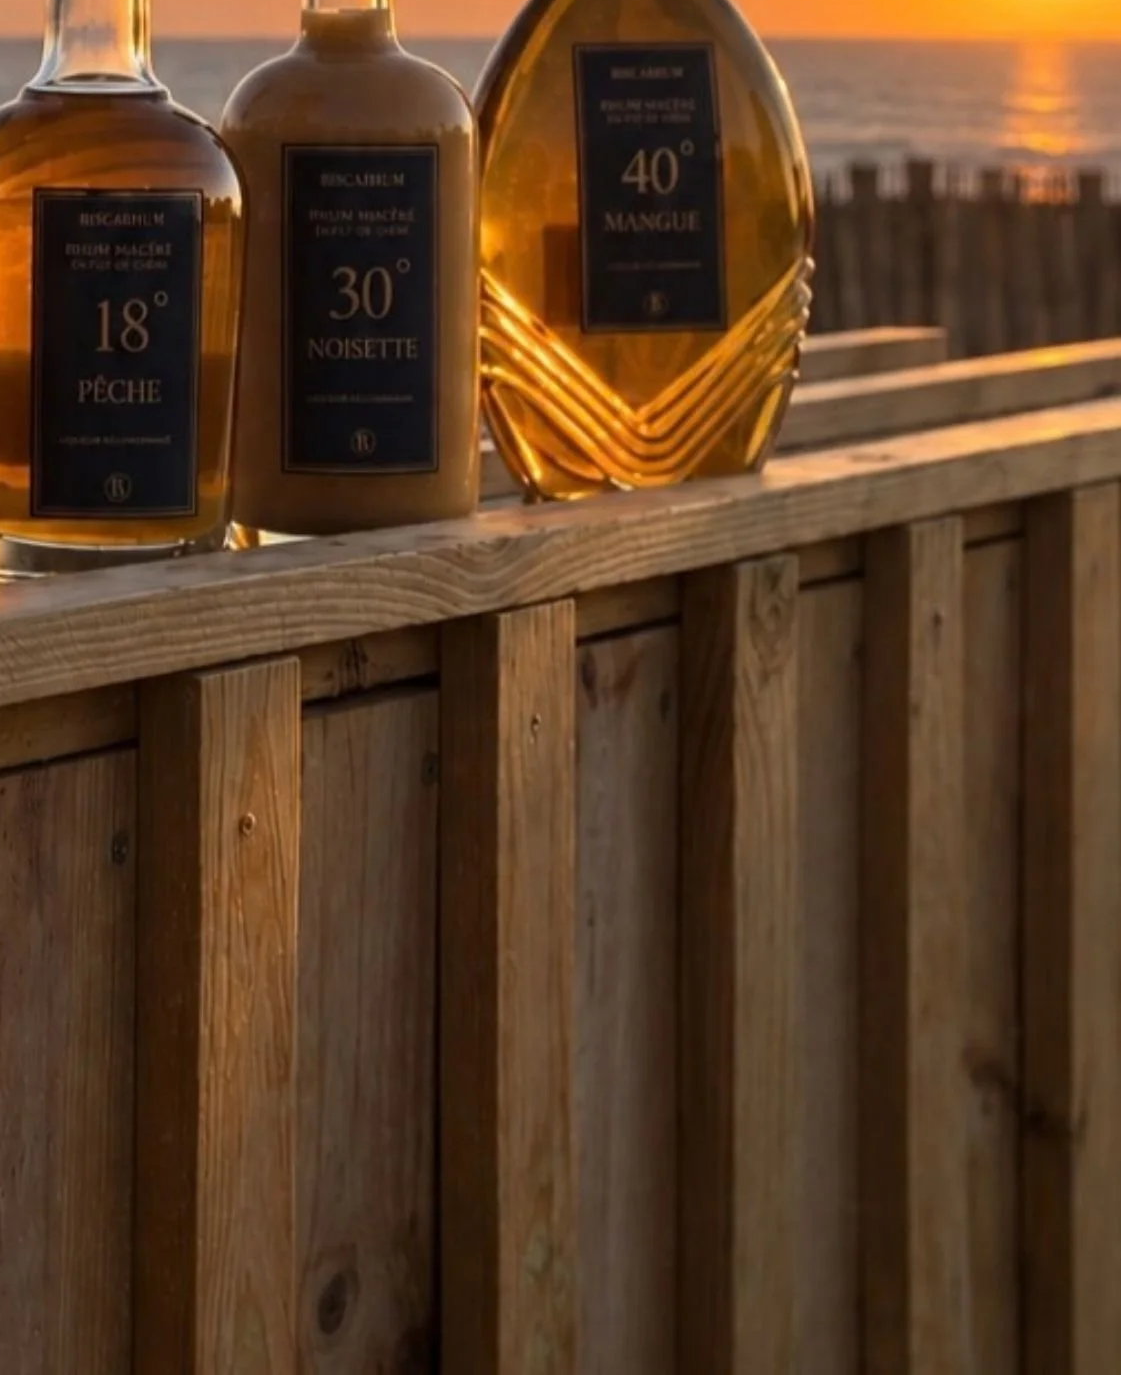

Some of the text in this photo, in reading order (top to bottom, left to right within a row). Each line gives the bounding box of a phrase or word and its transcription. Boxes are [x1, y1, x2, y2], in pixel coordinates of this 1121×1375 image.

[621, 138, 695, 195] 40°
[604, 210, 701, 234] MANGUE
[329, 258, 411, 321] 30°
[95, 290, 169, 353] 18°
[307, 336, 419, 360] NOISETTE
[77, 373, 162, 404] PÊCHE
